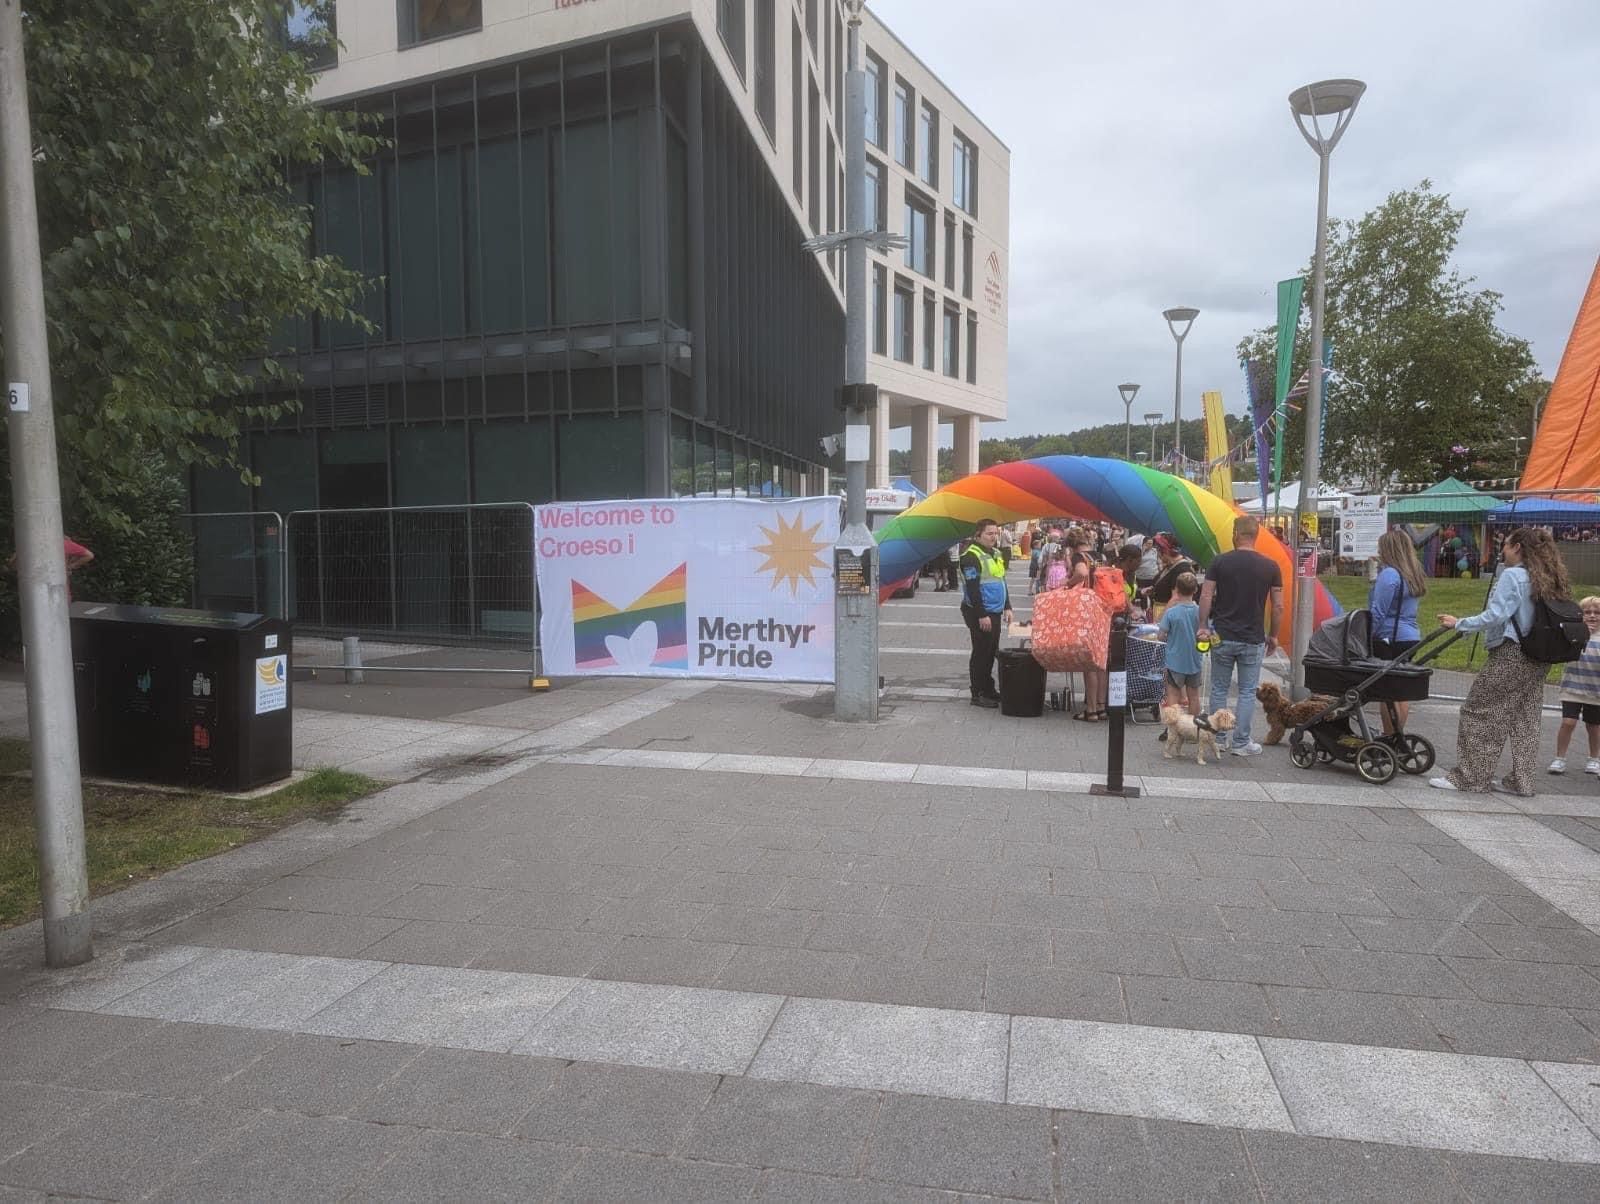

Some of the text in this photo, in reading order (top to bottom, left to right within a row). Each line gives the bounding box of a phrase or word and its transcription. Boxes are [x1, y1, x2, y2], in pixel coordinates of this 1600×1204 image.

[9, 390, 18, 405] 6
[539, 504, 674, 529] Welcome to
[539, 534, 634, 558] Croeso i
[698, 616, 816, 648] Merthyr
[698, 643, 772, 668] Pride
